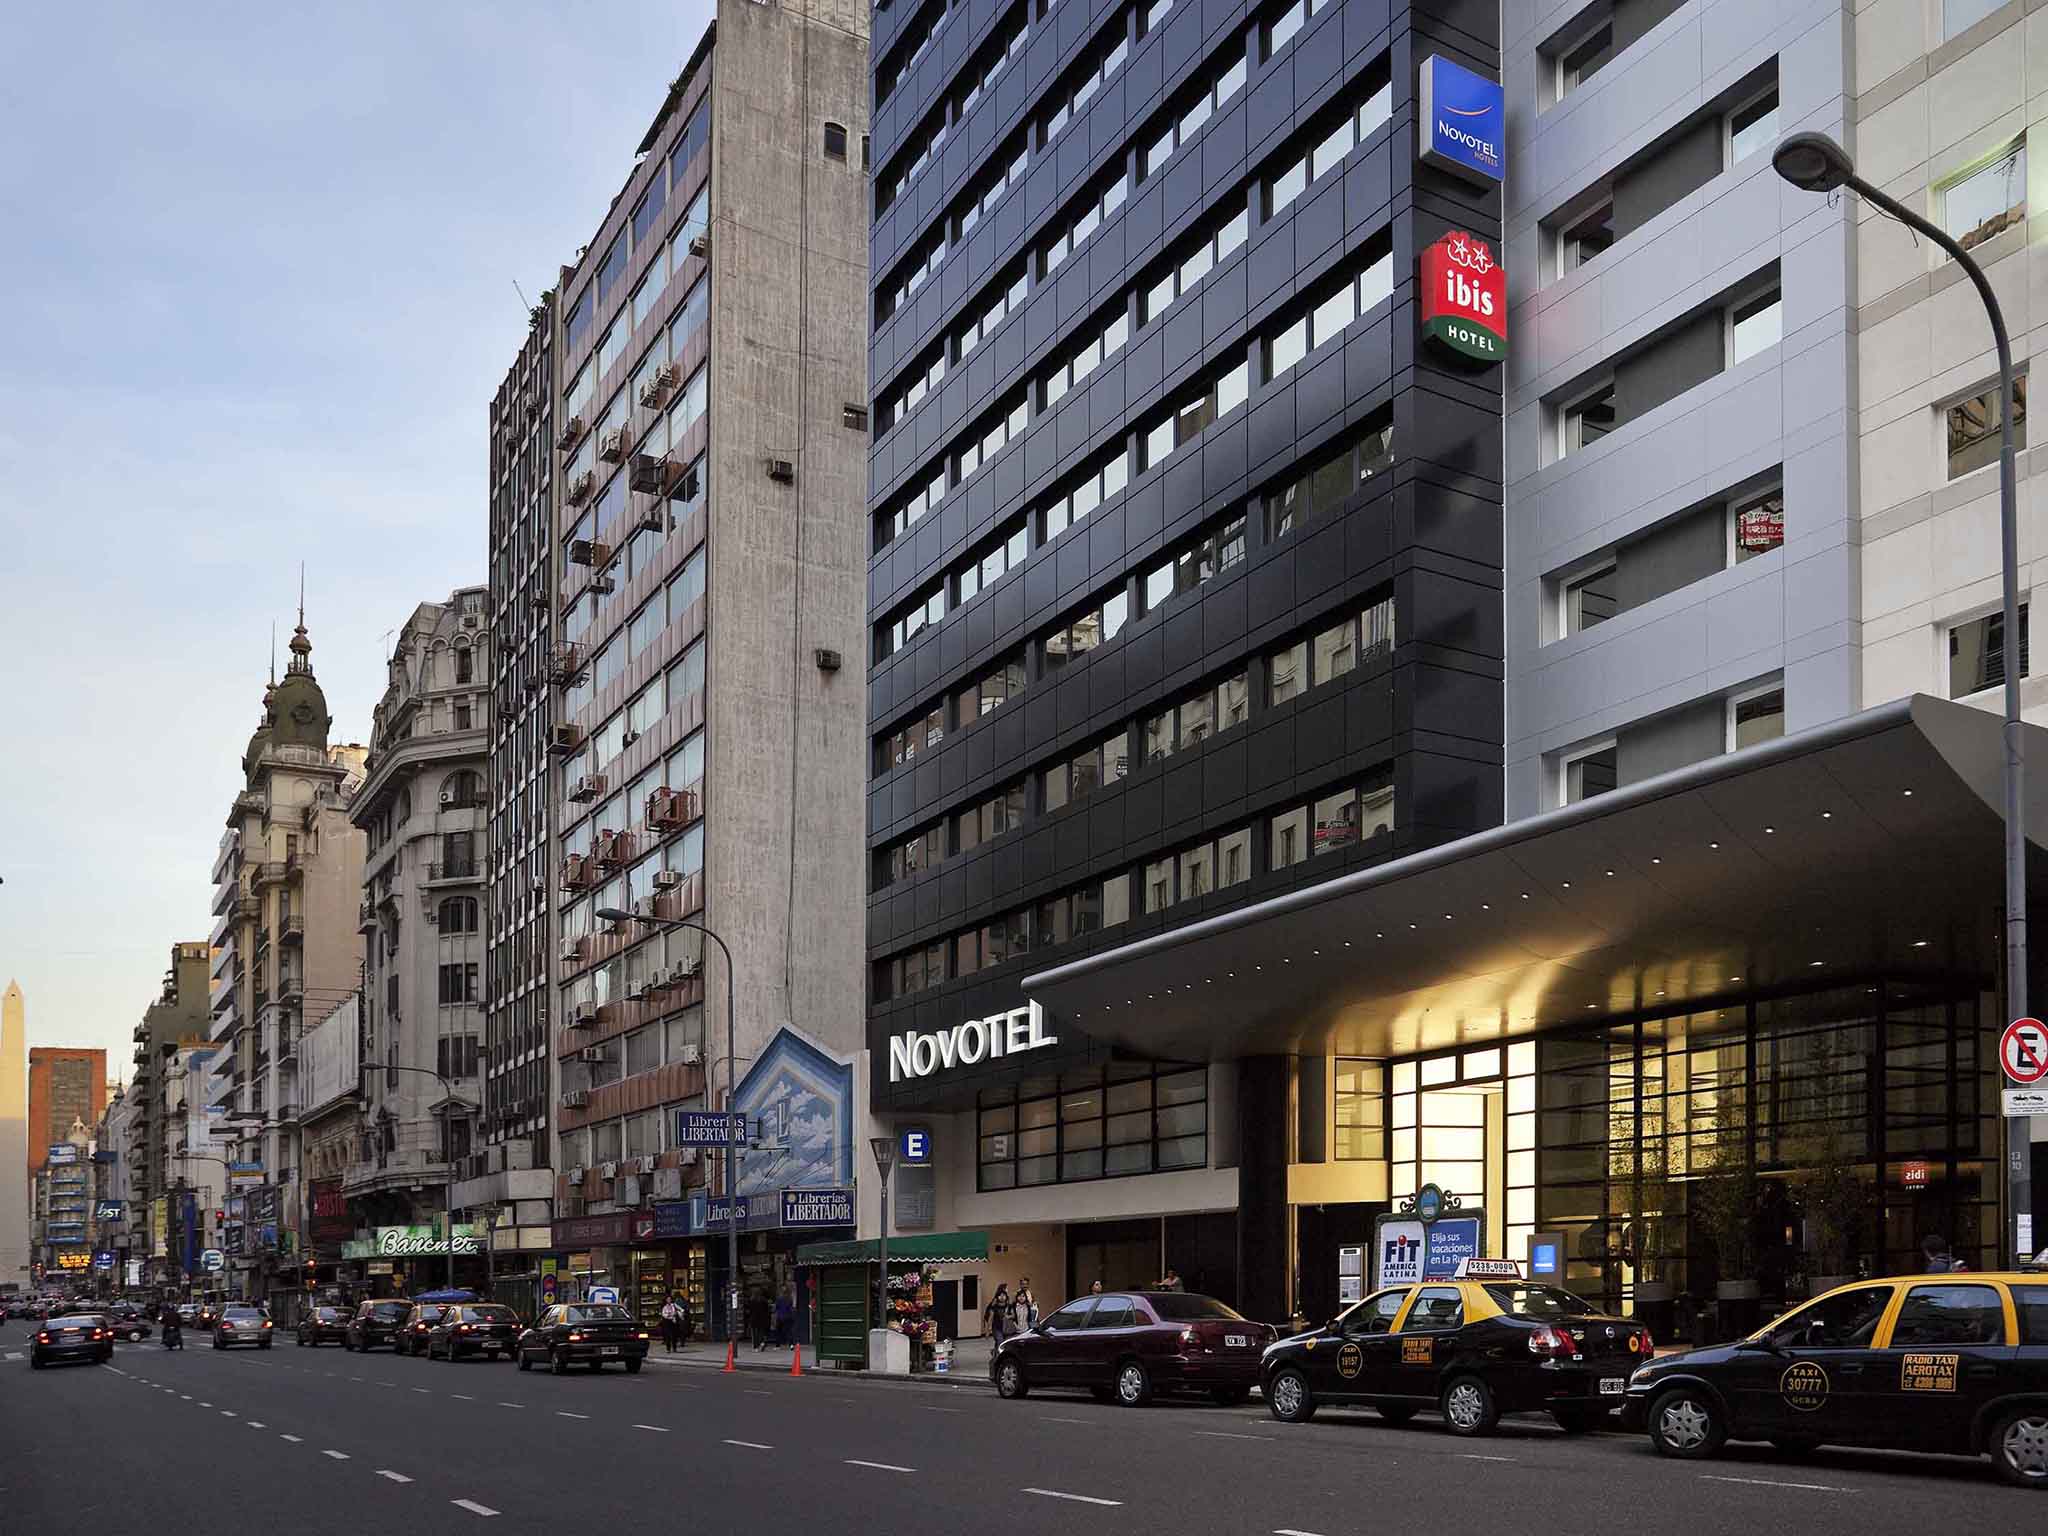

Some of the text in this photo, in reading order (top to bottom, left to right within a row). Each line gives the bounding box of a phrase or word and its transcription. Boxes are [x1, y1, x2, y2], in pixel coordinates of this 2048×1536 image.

[1439, 119, 1498, 159] NOVOTEL
[1447, 269, 1493, 316] ibis
[1448, 324, 1494, 352] HOTEL
[889, 998, 1058, 1083] NOVOTEL
[2017, 1032, 2038, 1067] E
[690, 1115, 744, 1127] Librerís
[683, 1127, 744, 1142] LIBERTAR
[908, 1134, 923, 1157] E
[799, 1193, 846, 1204] Librerías
[707, 1203, 746, 1222] Libreas
[787, 1203, 851, 1221] LIBERTADOR
[1432, 1233, 1446, 1244] Elija
[1431, 1244, 1473, 1254] vacaciones
[1442, 1255, 1451, 1264] La
[1471, 1261, 1513, 1270] 5238-0000
[1906, 1356, 1956, 1365] RADIO TAXI
[1793, 1368, 1818, 1377] TAXI
[1905, 1365, 1953, 1376] AEROTAX
[1787, 1378, 1822, 1391] 30777
